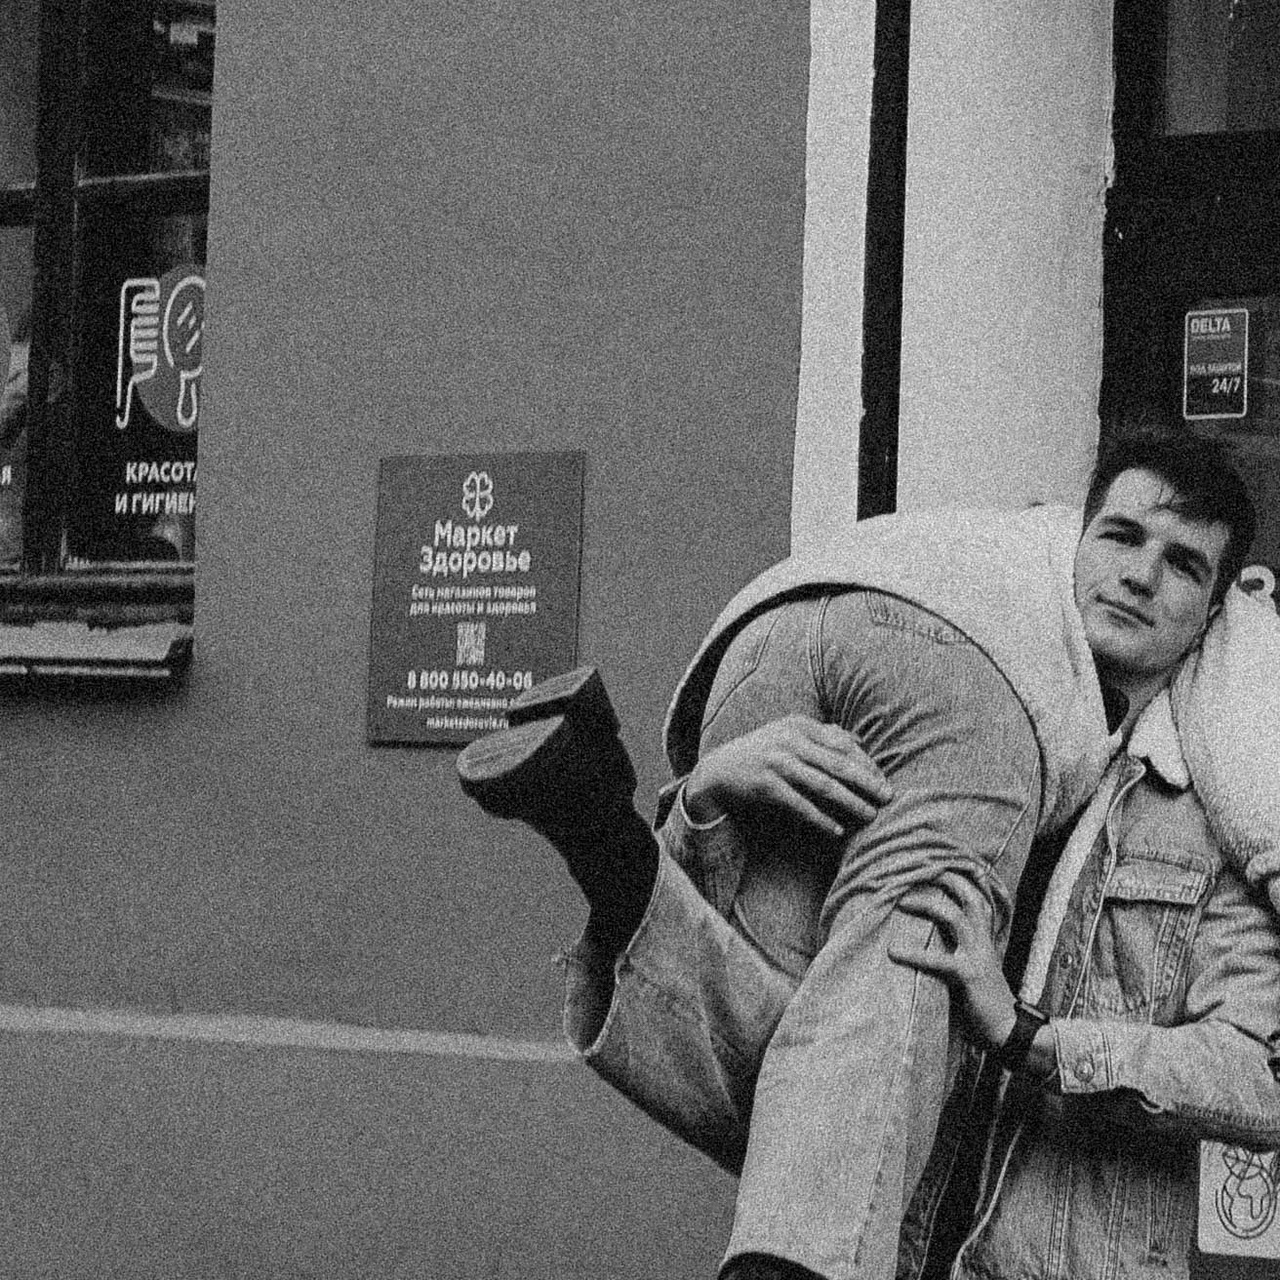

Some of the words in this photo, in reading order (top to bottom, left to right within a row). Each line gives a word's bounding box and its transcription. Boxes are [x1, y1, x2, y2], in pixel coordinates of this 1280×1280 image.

[1190, 317, 1231, 333] DELTA
[1211, 377, 1241, 394] 24/7
[125, 461, 197, 483] КРАСОТ
[114, 493, 128, 514] И
[434, 520, 519, 550] Маркет
[419, 545, 531, 578] Здоровье
[407, 670, 417, 690] 8
[420, 670, 449, 690] 800
